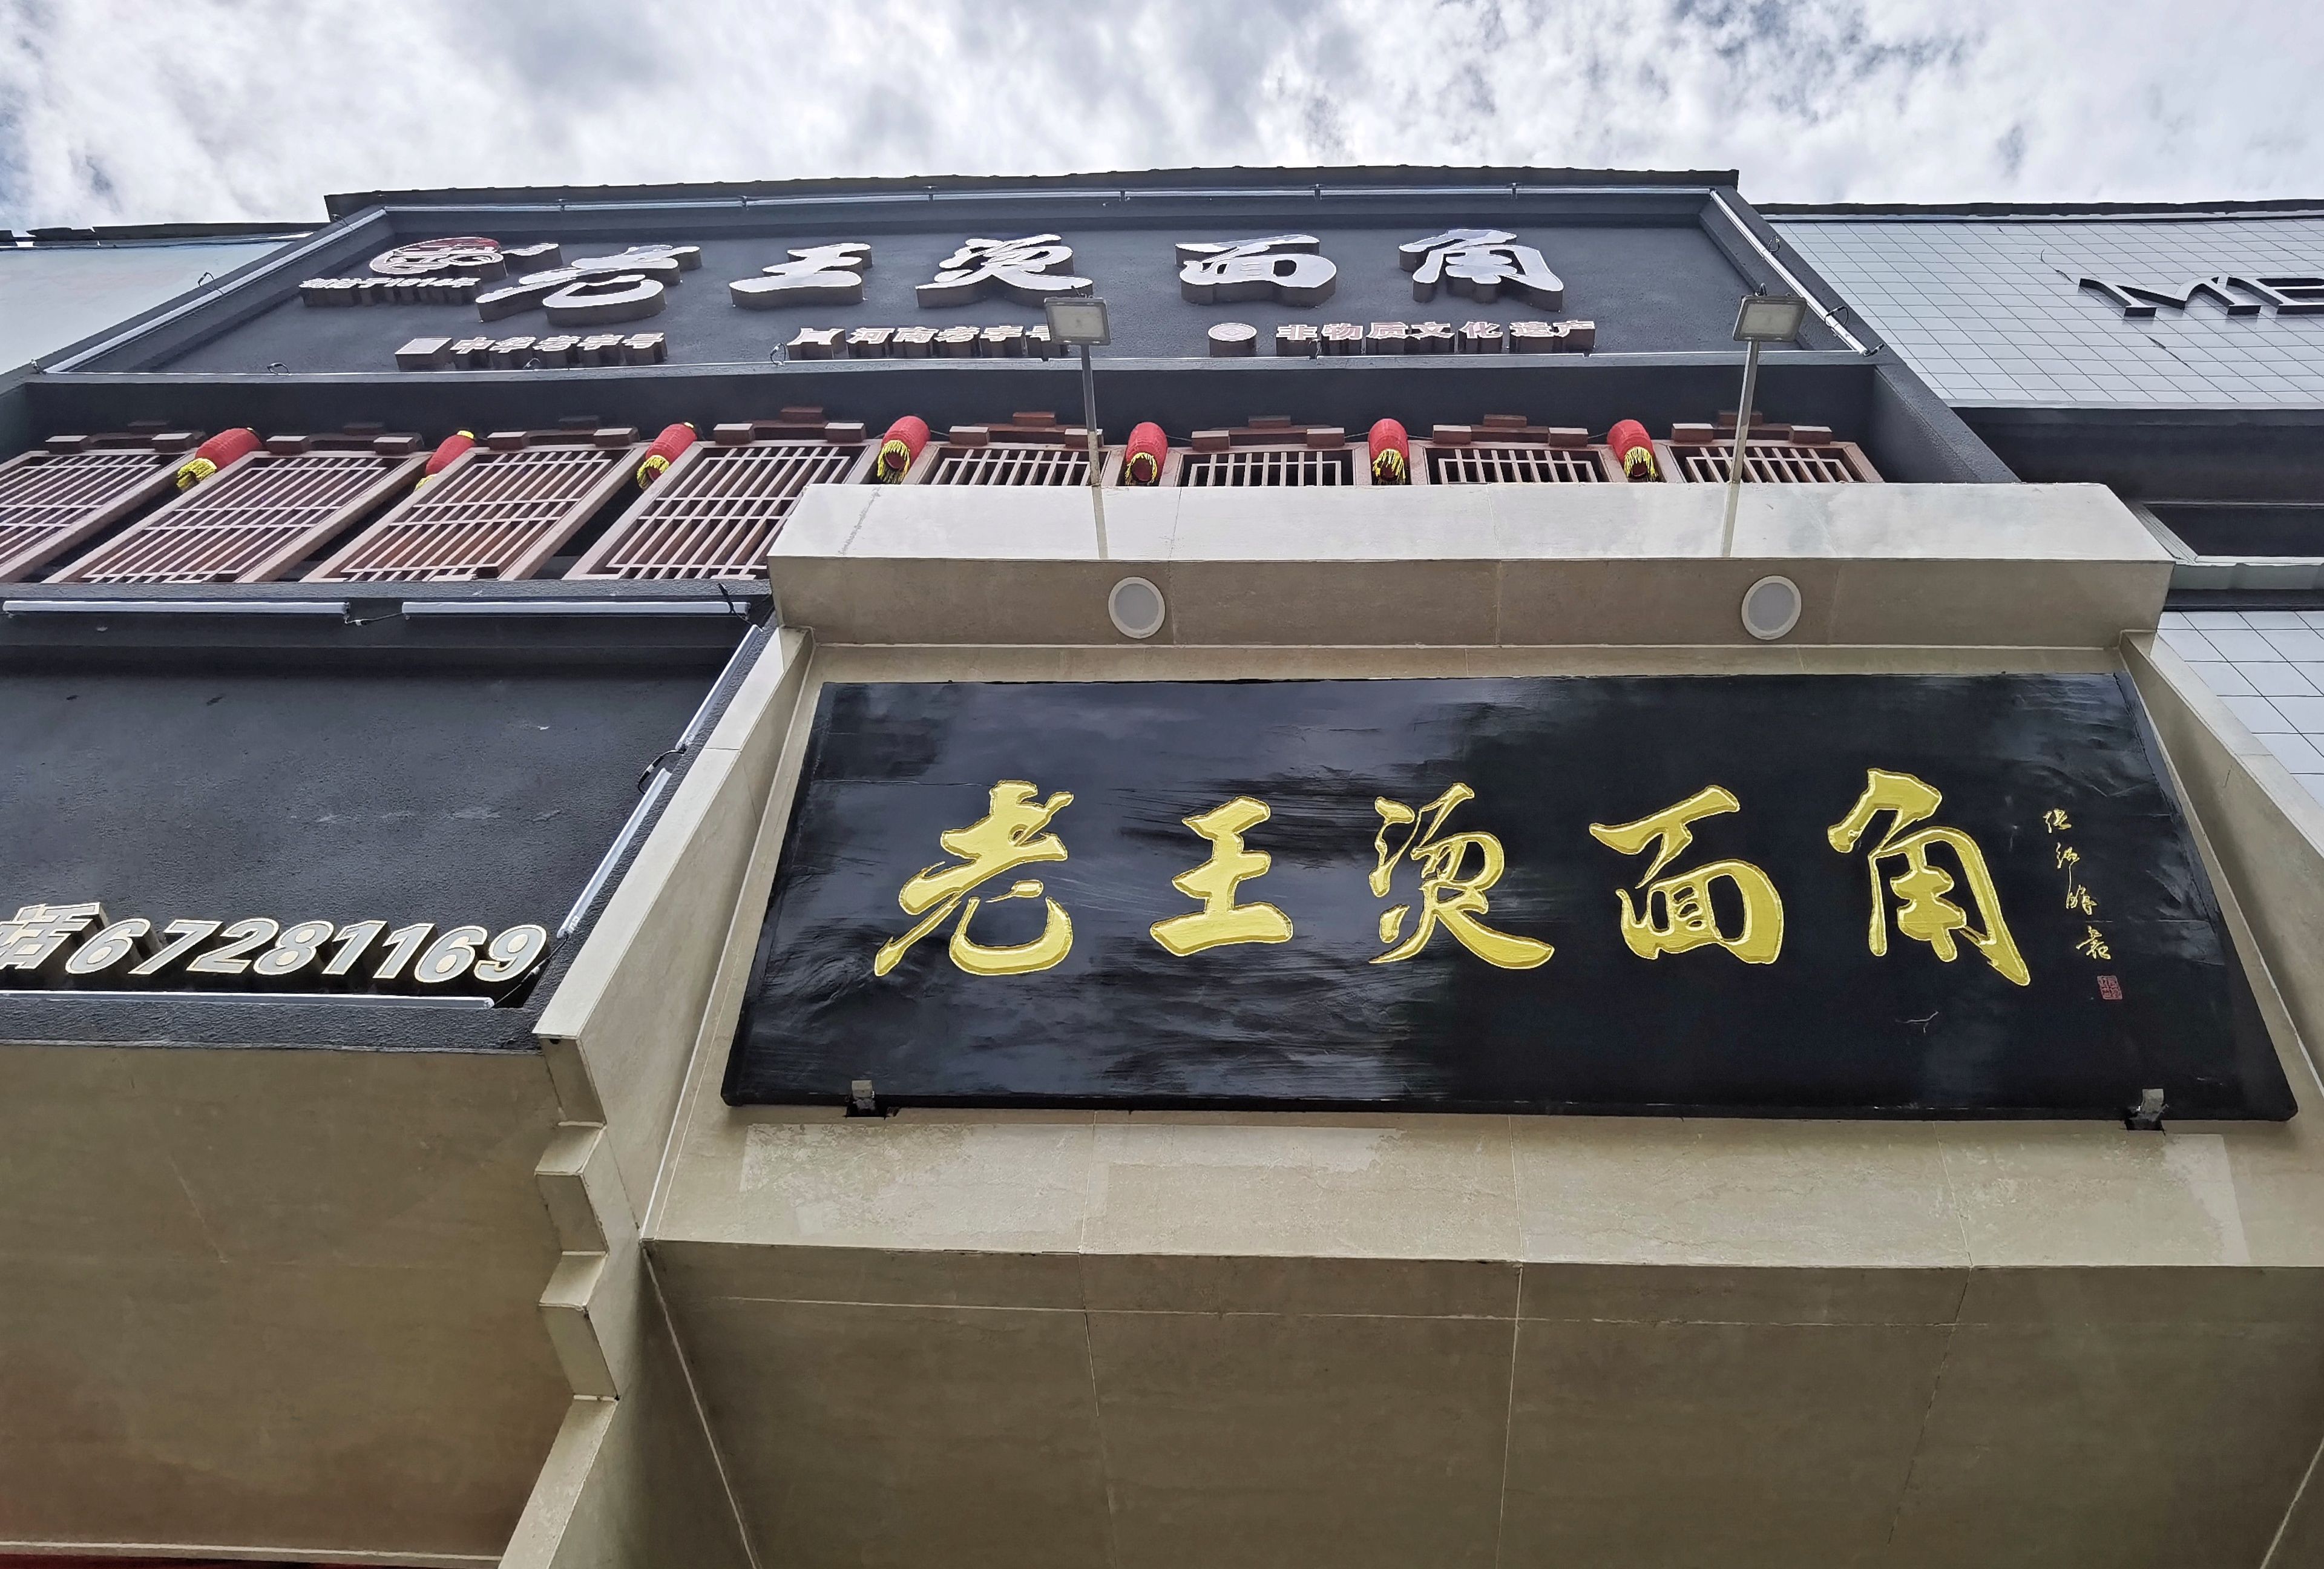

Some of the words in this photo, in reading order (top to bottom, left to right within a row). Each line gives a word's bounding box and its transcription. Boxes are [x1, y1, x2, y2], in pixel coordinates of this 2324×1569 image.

[476, 229, 1564, 308] 老王烫面角
[450, 332, 664, 354] 中华老字号
[1276, 321, 1595, 340] 非物质文化遗产
[873, 768, 2031, 987] 老王烫面角
